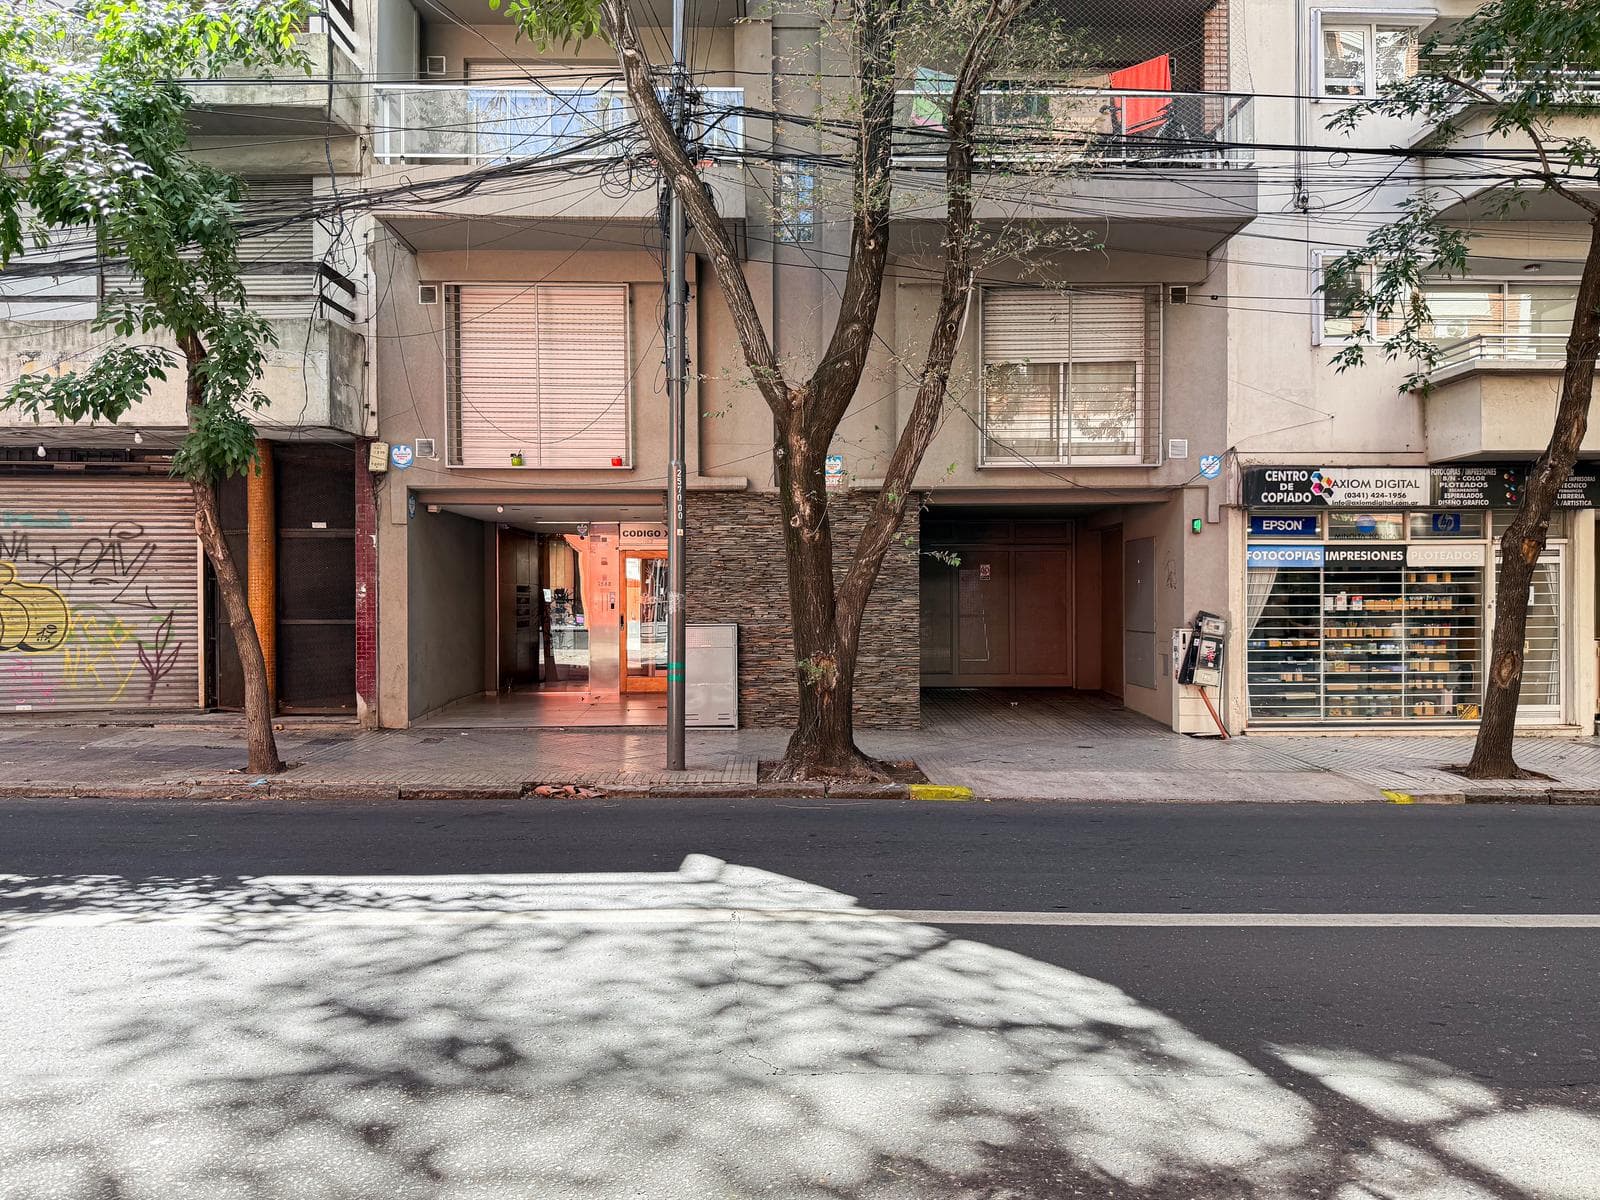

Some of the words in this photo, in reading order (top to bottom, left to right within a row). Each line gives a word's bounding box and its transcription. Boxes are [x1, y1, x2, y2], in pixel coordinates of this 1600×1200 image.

[1265, 470, 1308, 482] CENTRO
[1430, 468, 1460, 476] FOTOCOPIAS
[1280, 483, 1294, 491] DE
[1332, 479, 1371, 489] AXIOM
[1375, 479, 1420, 489] DIGITAL
[1261, 492, 1312, 503] COPIADO
[1262, 520, 1303, 531] EPSON
[622, 530, 661, 538] CODIGO
[1247, 551, 1321, 561] FOTOCOPIAS
[1325, 551, 1404, 561] IMPRESIONES
[1411, 551, 1480, 561] PLOTEADOS
